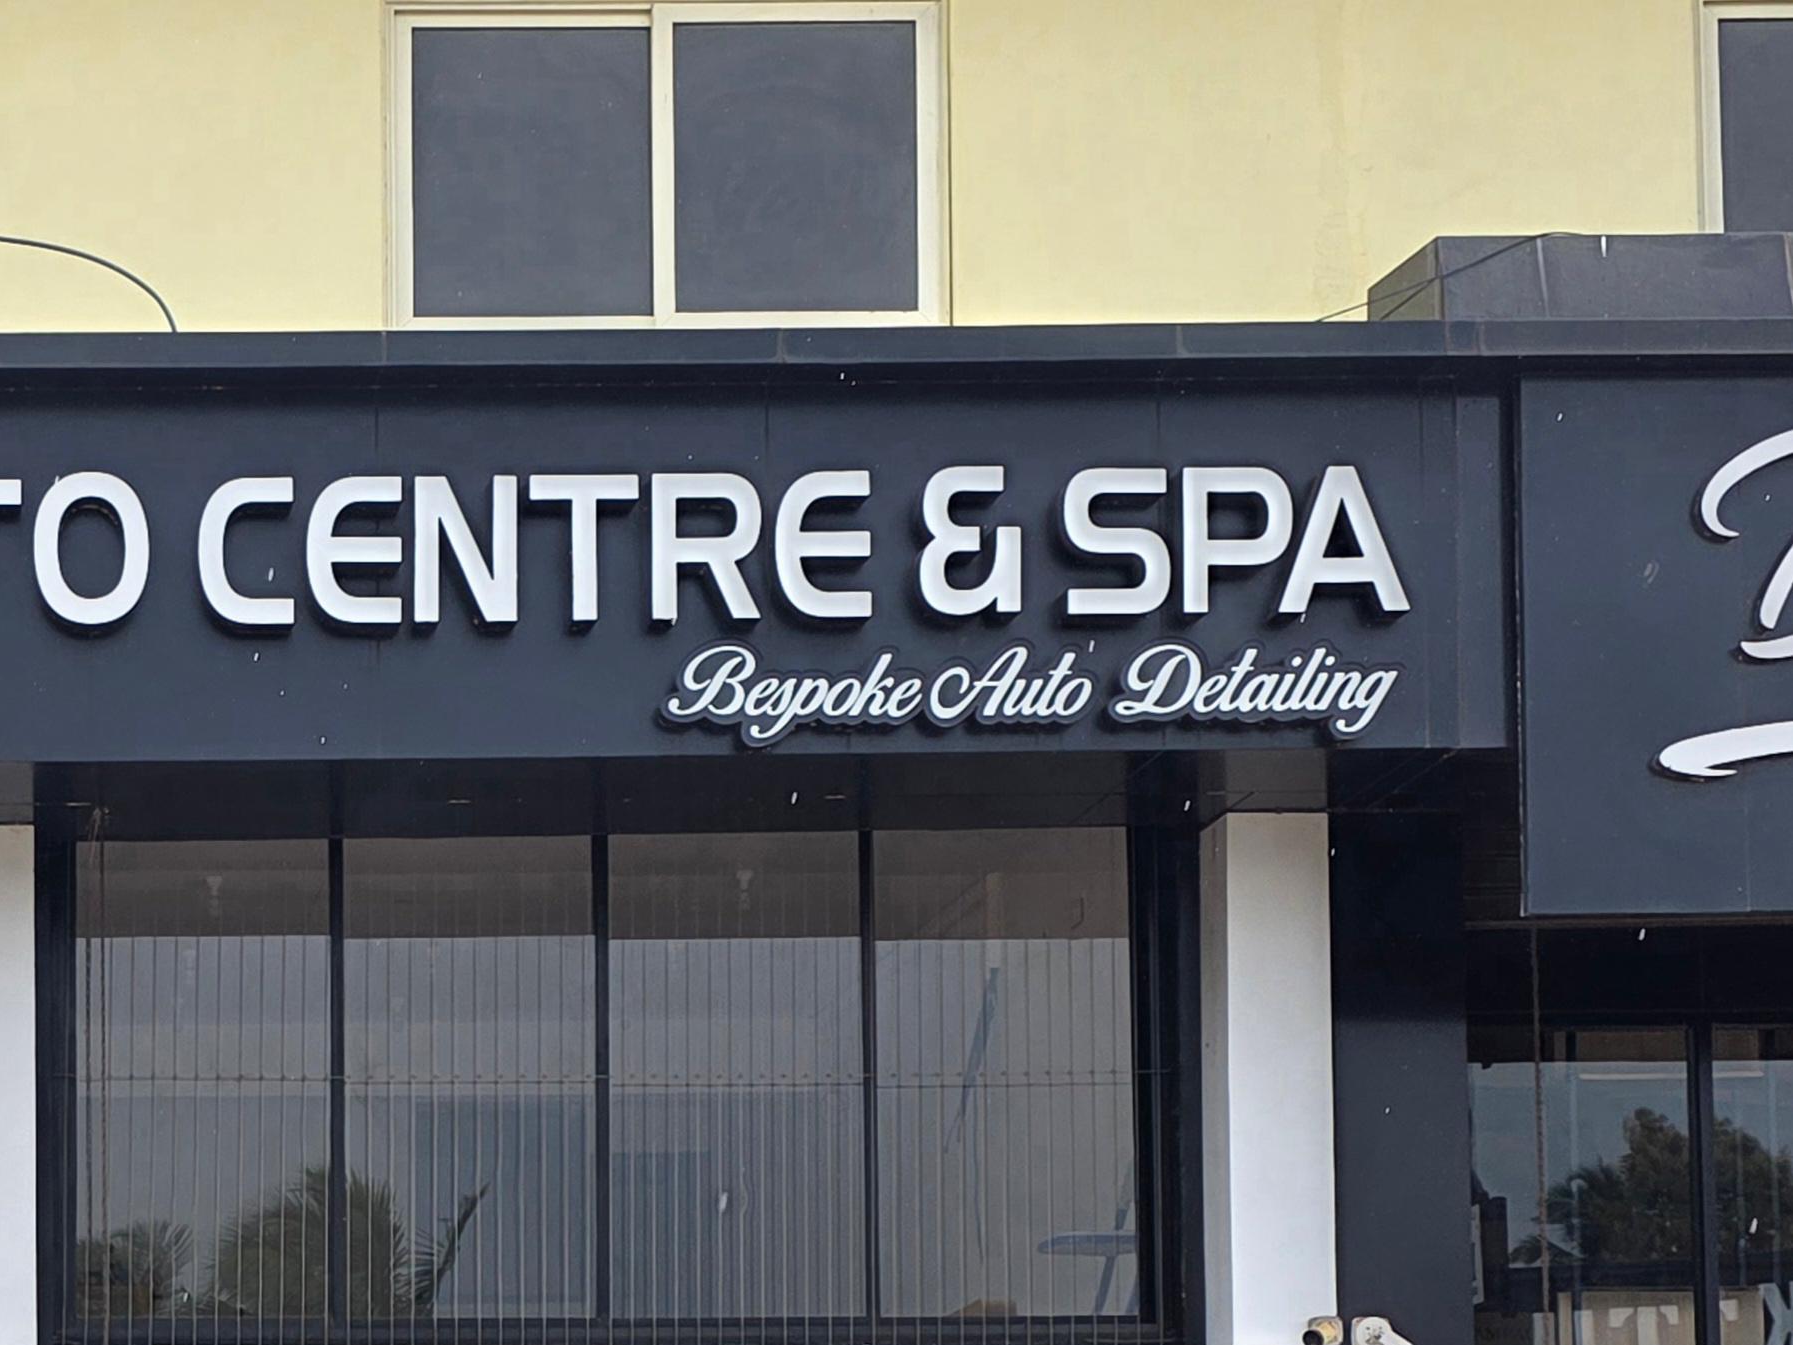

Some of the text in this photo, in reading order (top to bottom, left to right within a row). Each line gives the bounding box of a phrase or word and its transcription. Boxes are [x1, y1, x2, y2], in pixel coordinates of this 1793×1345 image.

[198, 471, 873, 625] CENTRE
[919, 465, 1022, 615] &
[1064, 465, 1411, 615] SPA
[667, 643, 1399, 739] Bespoke Auto Detailing
